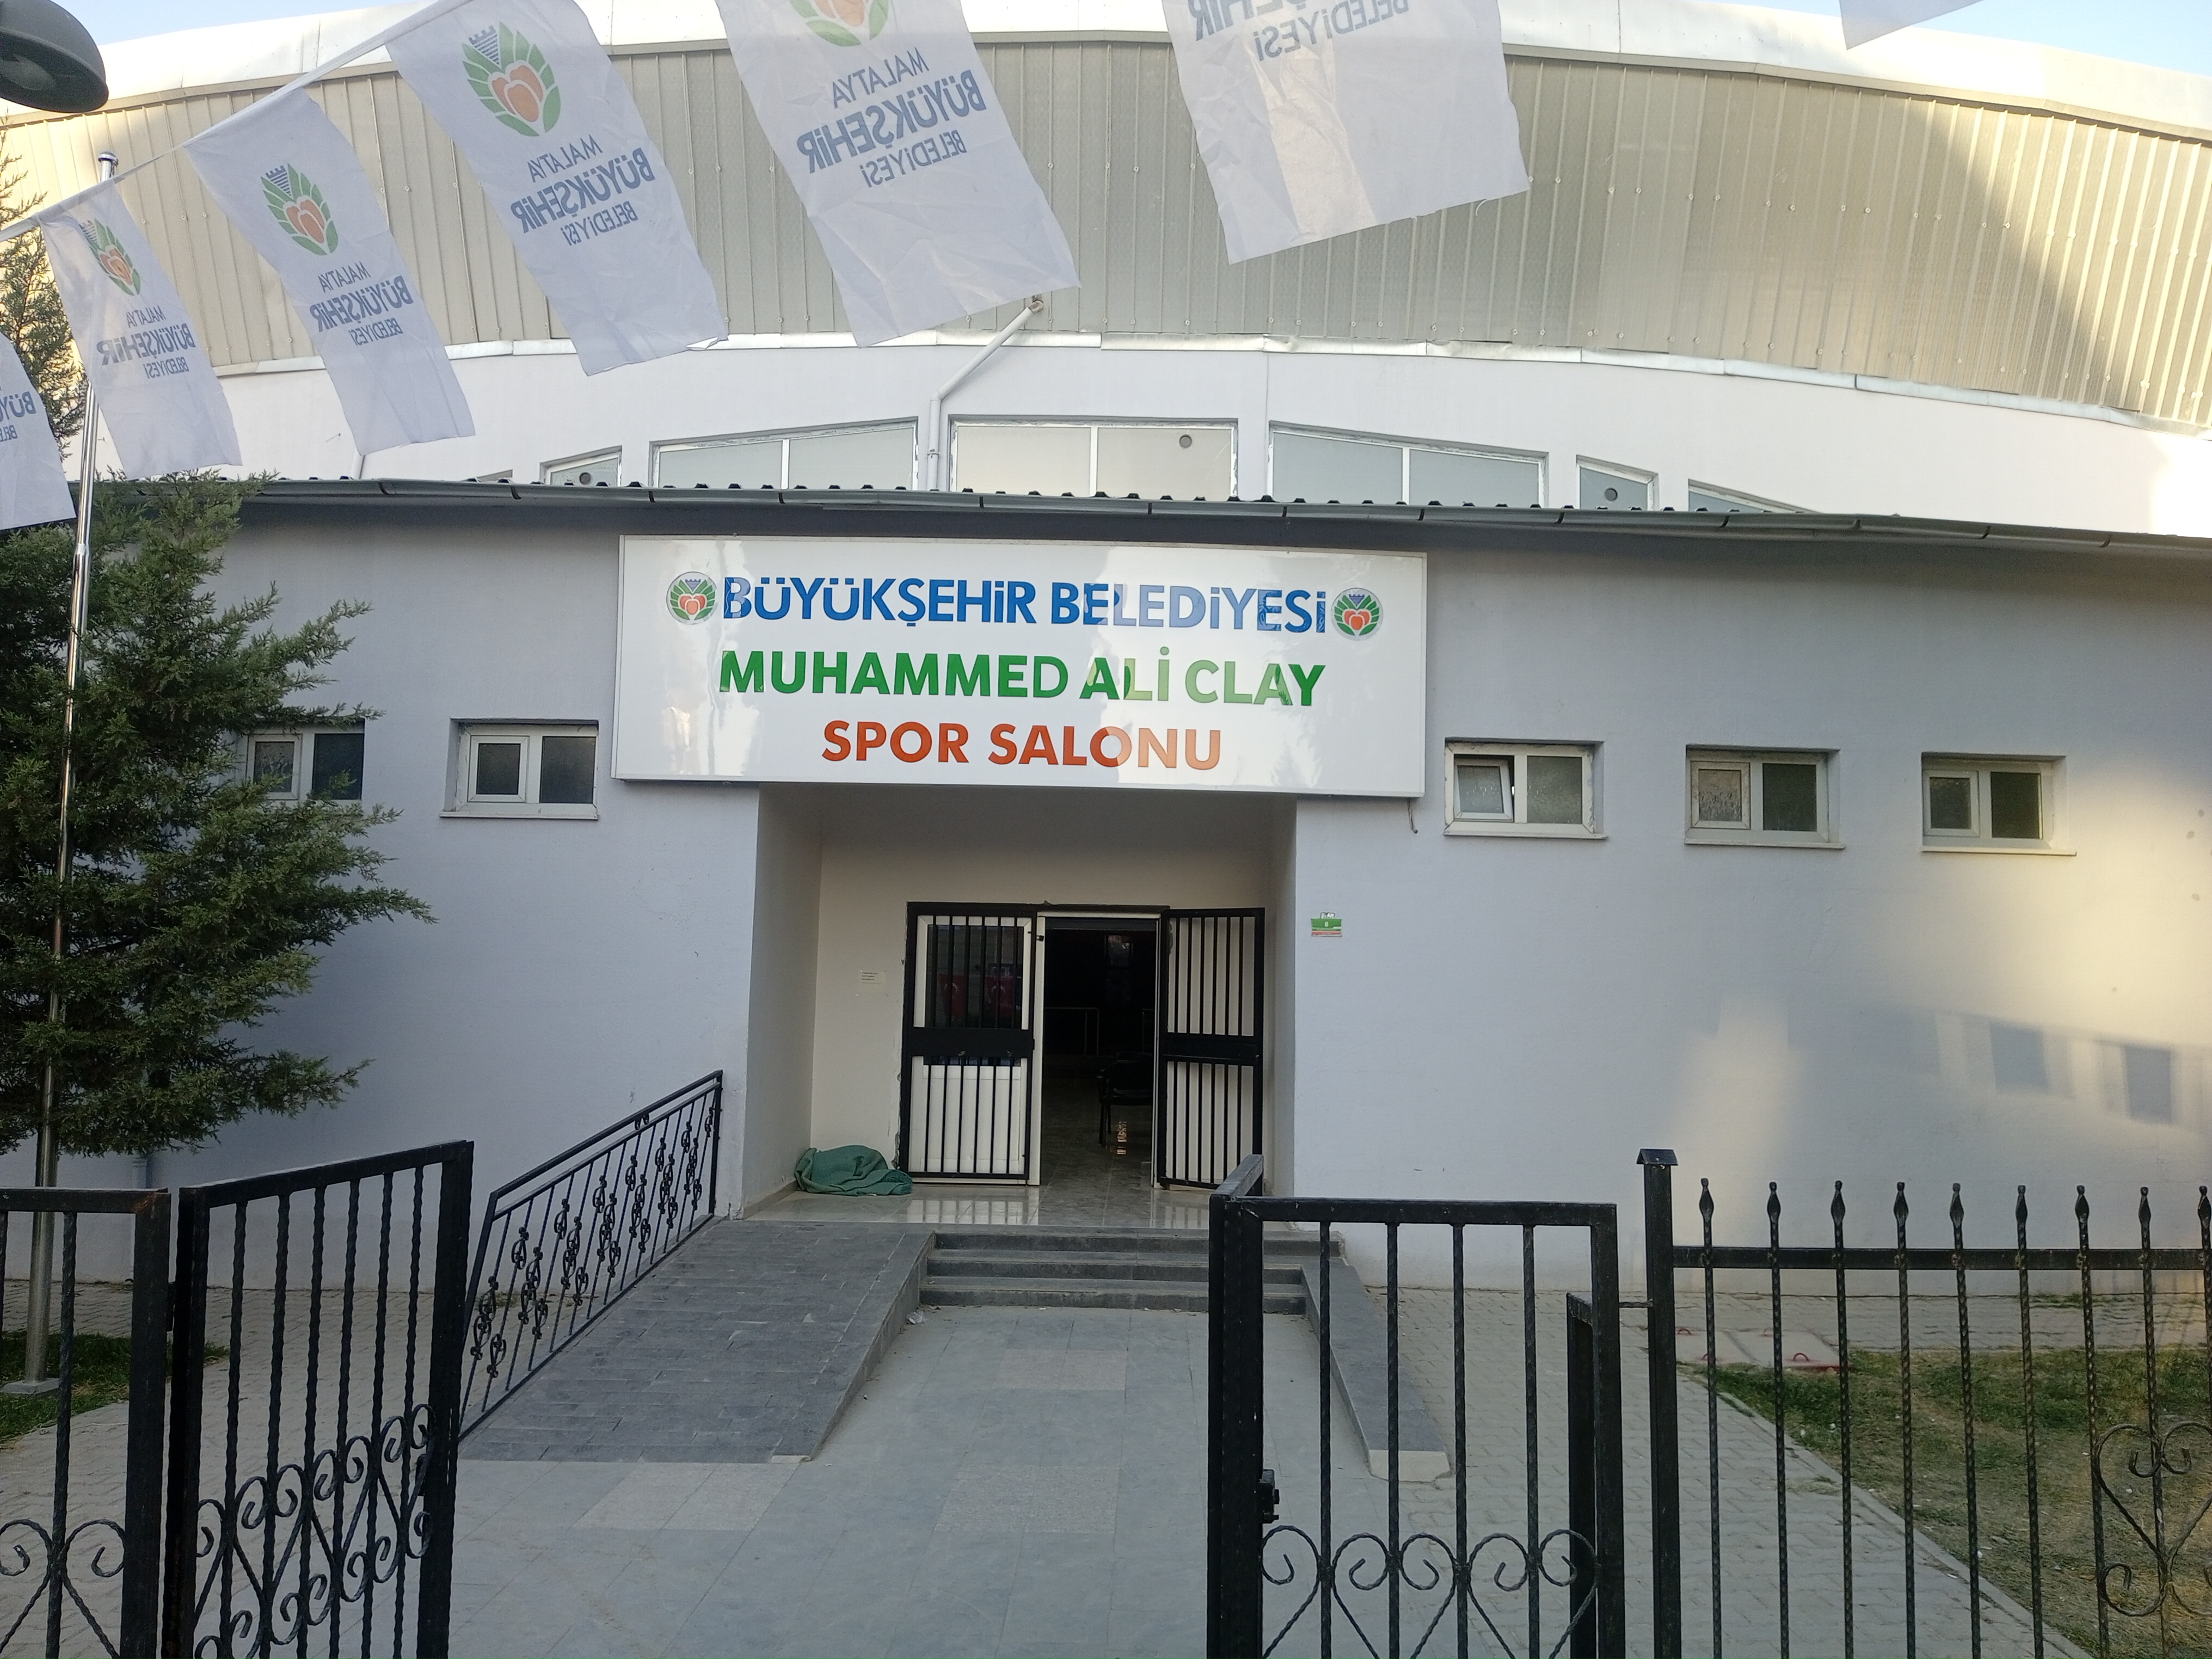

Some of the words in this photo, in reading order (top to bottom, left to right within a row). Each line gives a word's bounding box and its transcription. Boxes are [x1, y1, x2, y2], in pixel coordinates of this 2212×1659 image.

[723, 577, 1037, 626] BÜYÜKŞEHİR
[1051, 582, 1326, 633] BELEDİYESİ
[719, 650, 1068, 698] MUHAMMED
[1079, 646, 1170, 702] ALİ
[1185, 660, 1326, 706] CLAY
[822, 720, 969, 763] SPOR
[988, 723, 1221, 770] SALONU
